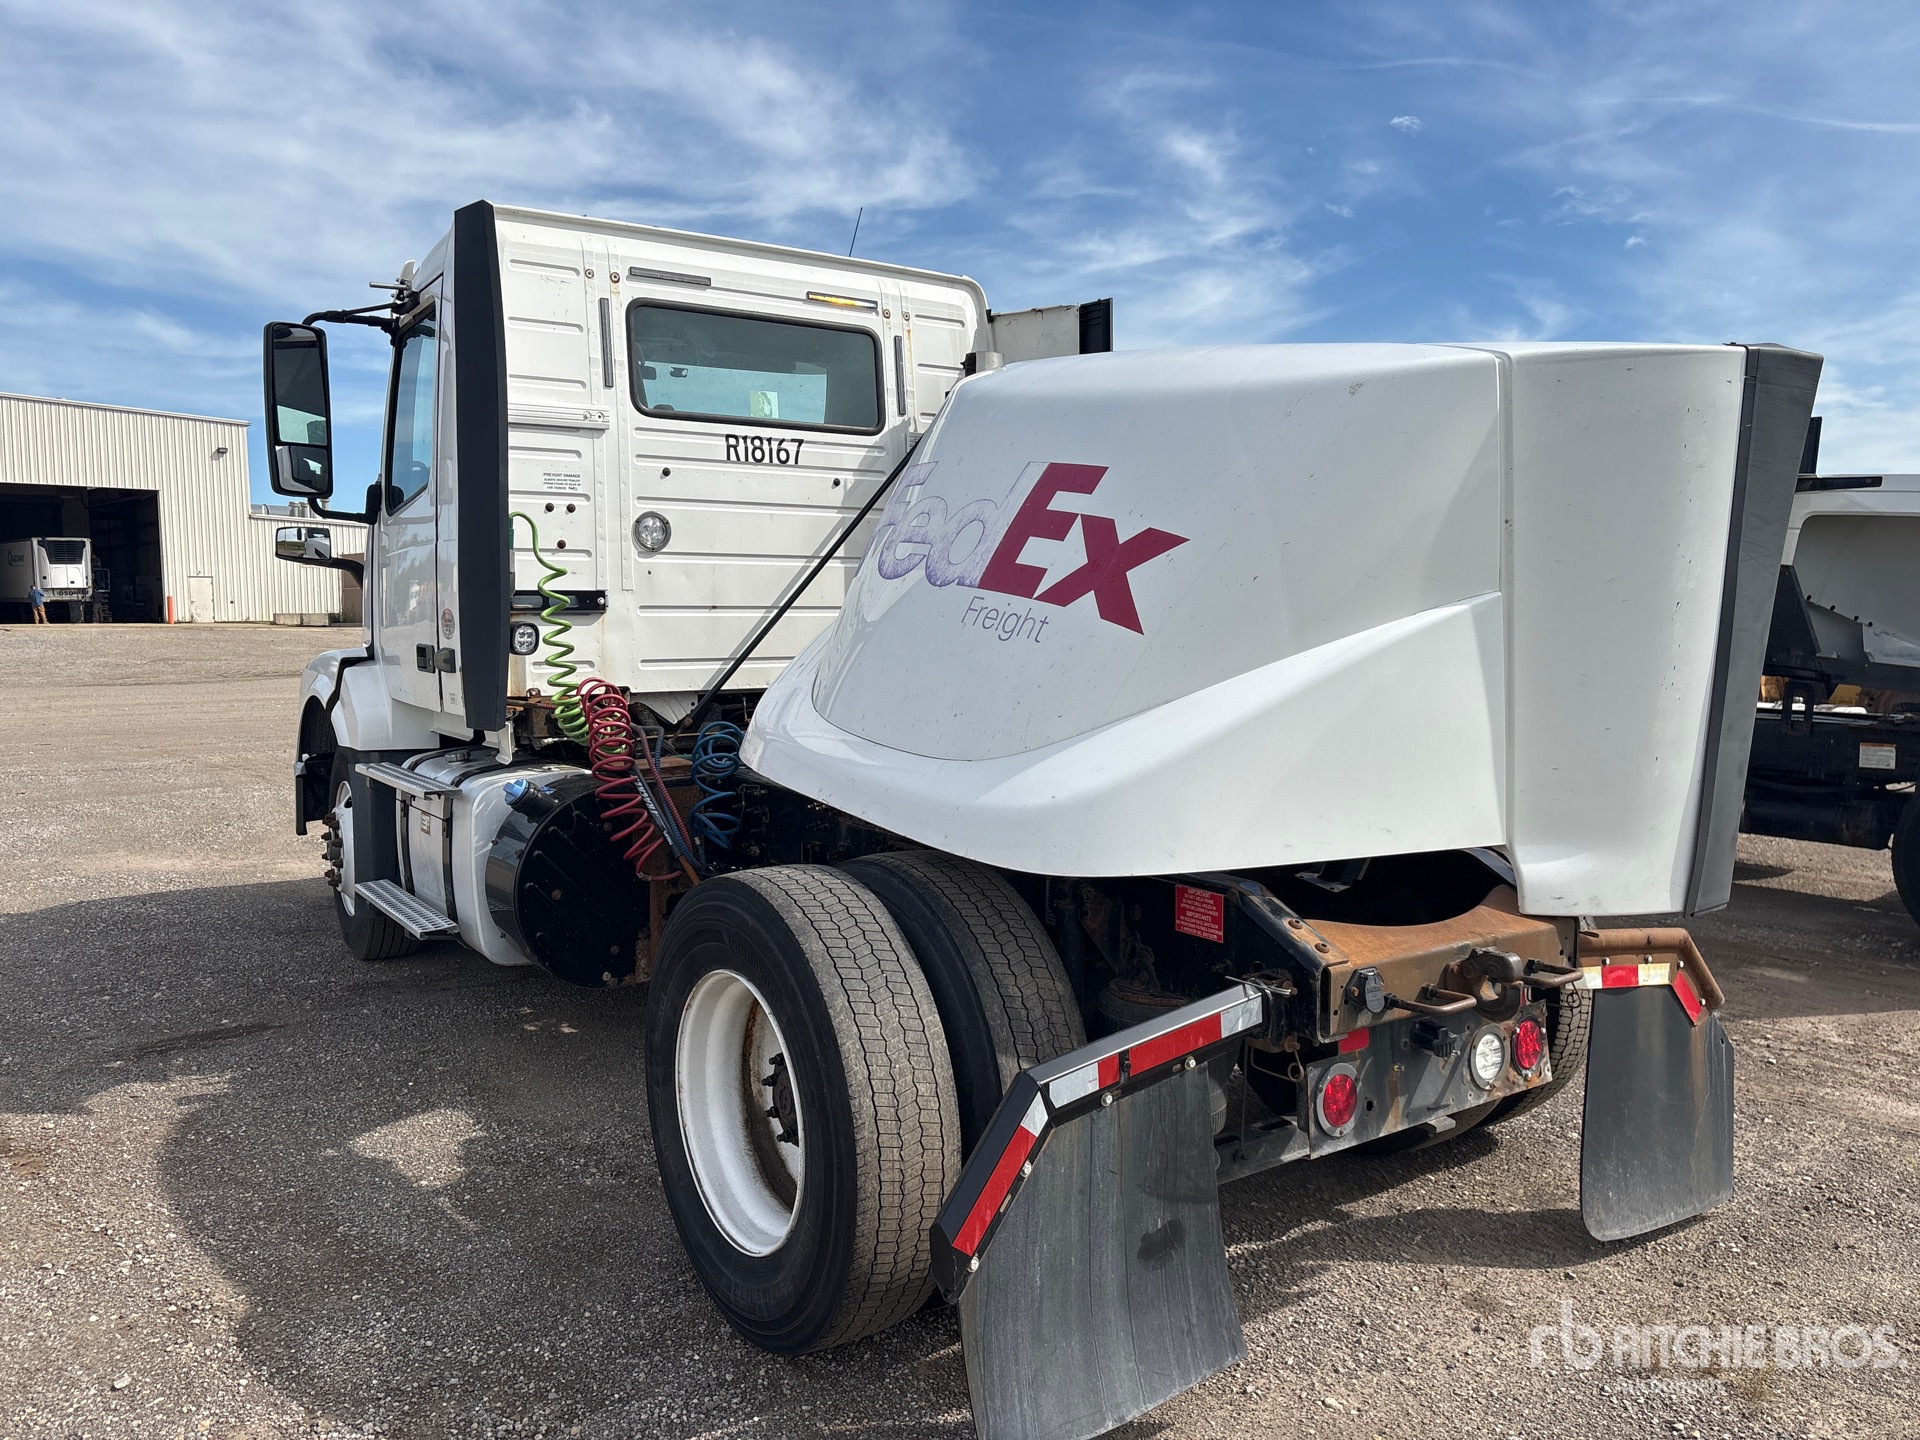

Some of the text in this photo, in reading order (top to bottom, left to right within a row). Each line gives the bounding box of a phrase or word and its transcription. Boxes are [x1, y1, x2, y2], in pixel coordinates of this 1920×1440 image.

[725, 433, 805, 465] R18167
[854, 460, 1191, 636] FedEx
[960, 595, 1050, 643] Freight
[1187, 888, 1211, 899] IMPORTANT
[1186, 910, 1212, 922] IMPORTANTE
